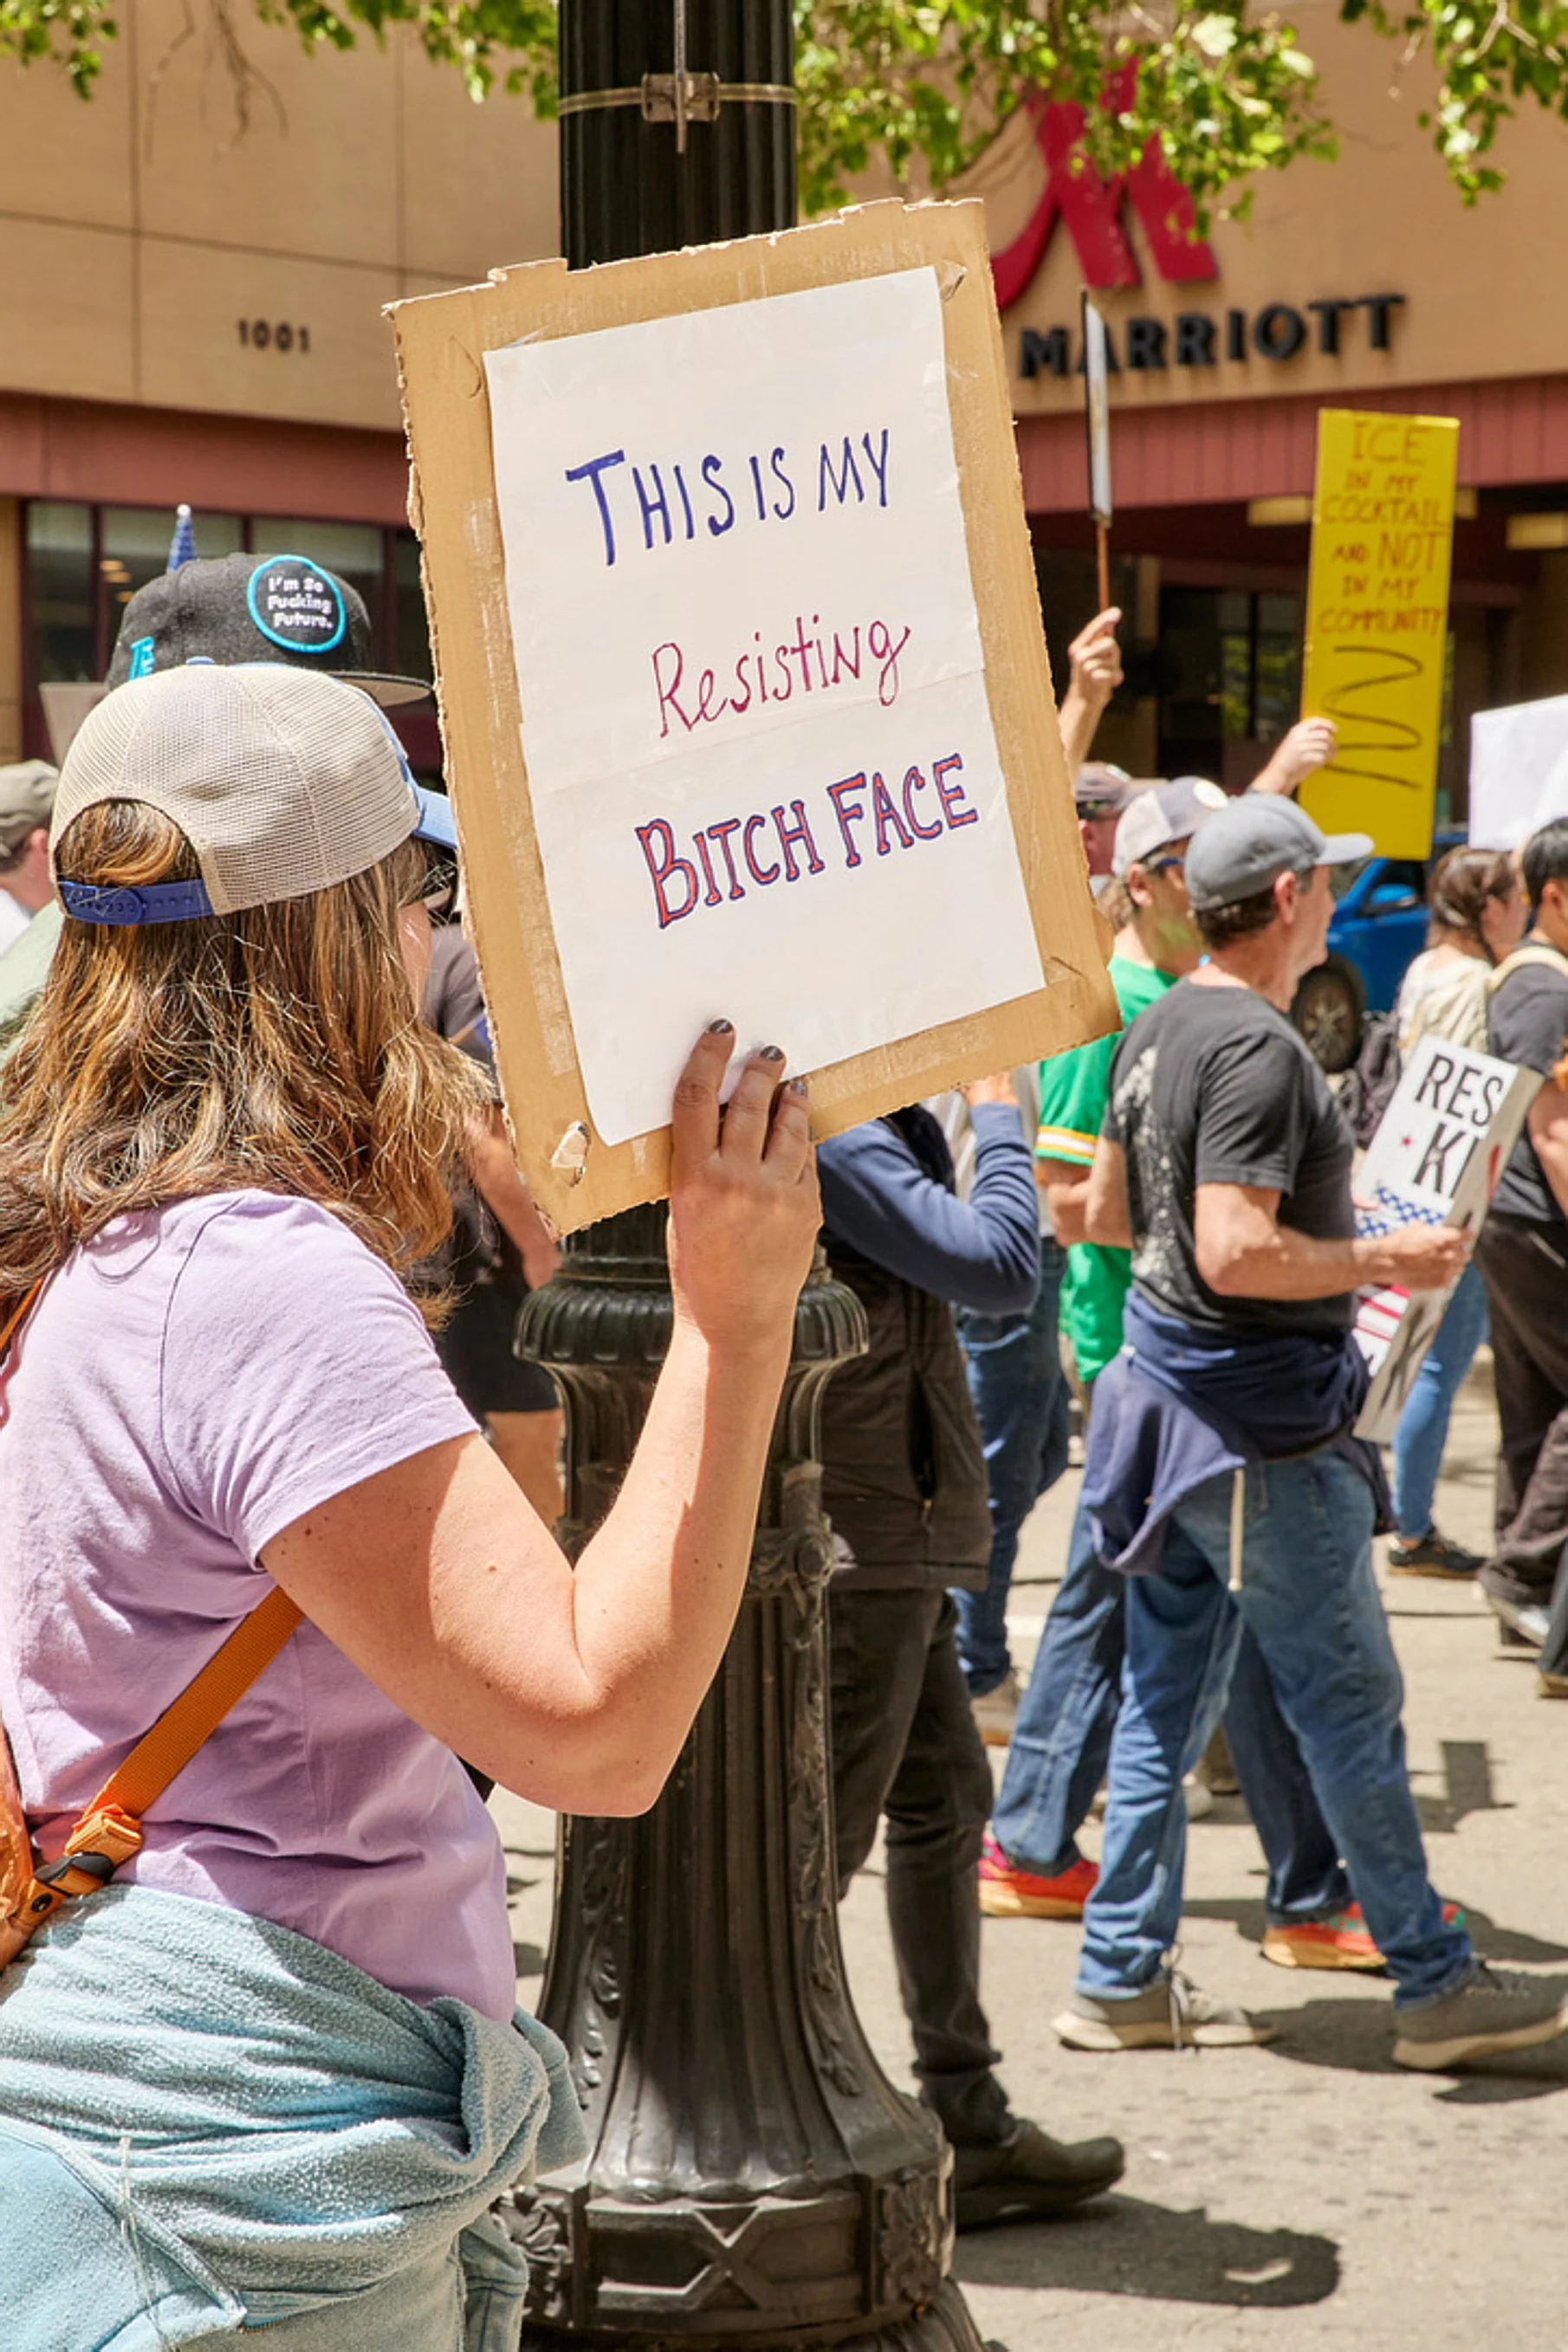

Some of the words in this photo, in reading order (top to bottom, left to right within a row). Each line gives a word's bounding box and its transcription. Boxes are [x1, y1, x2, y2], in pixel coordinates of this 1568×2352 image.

[237, 317, 311, 354] 1001
[1351, 421, 1429, 465] ICE
[565, 449, 735, 566] THIS
[749, 446, 795, 520] IS
[817, 428, 889, 513] MY
[1386, 474, 1419, 493] MY
[1322, 494, 1449, 528] COCKTAIL
[1377, 531, 1448, 572] NOT
[268, 576, 300, 593] I'm
[302, 577, 325, 593] So
[1343, 573, 1368, 597] IN
[1377, 578, 1421, 600] MY
[635, 800, 825, 929] BITCH
[826, 753, 979, 869] FACE
